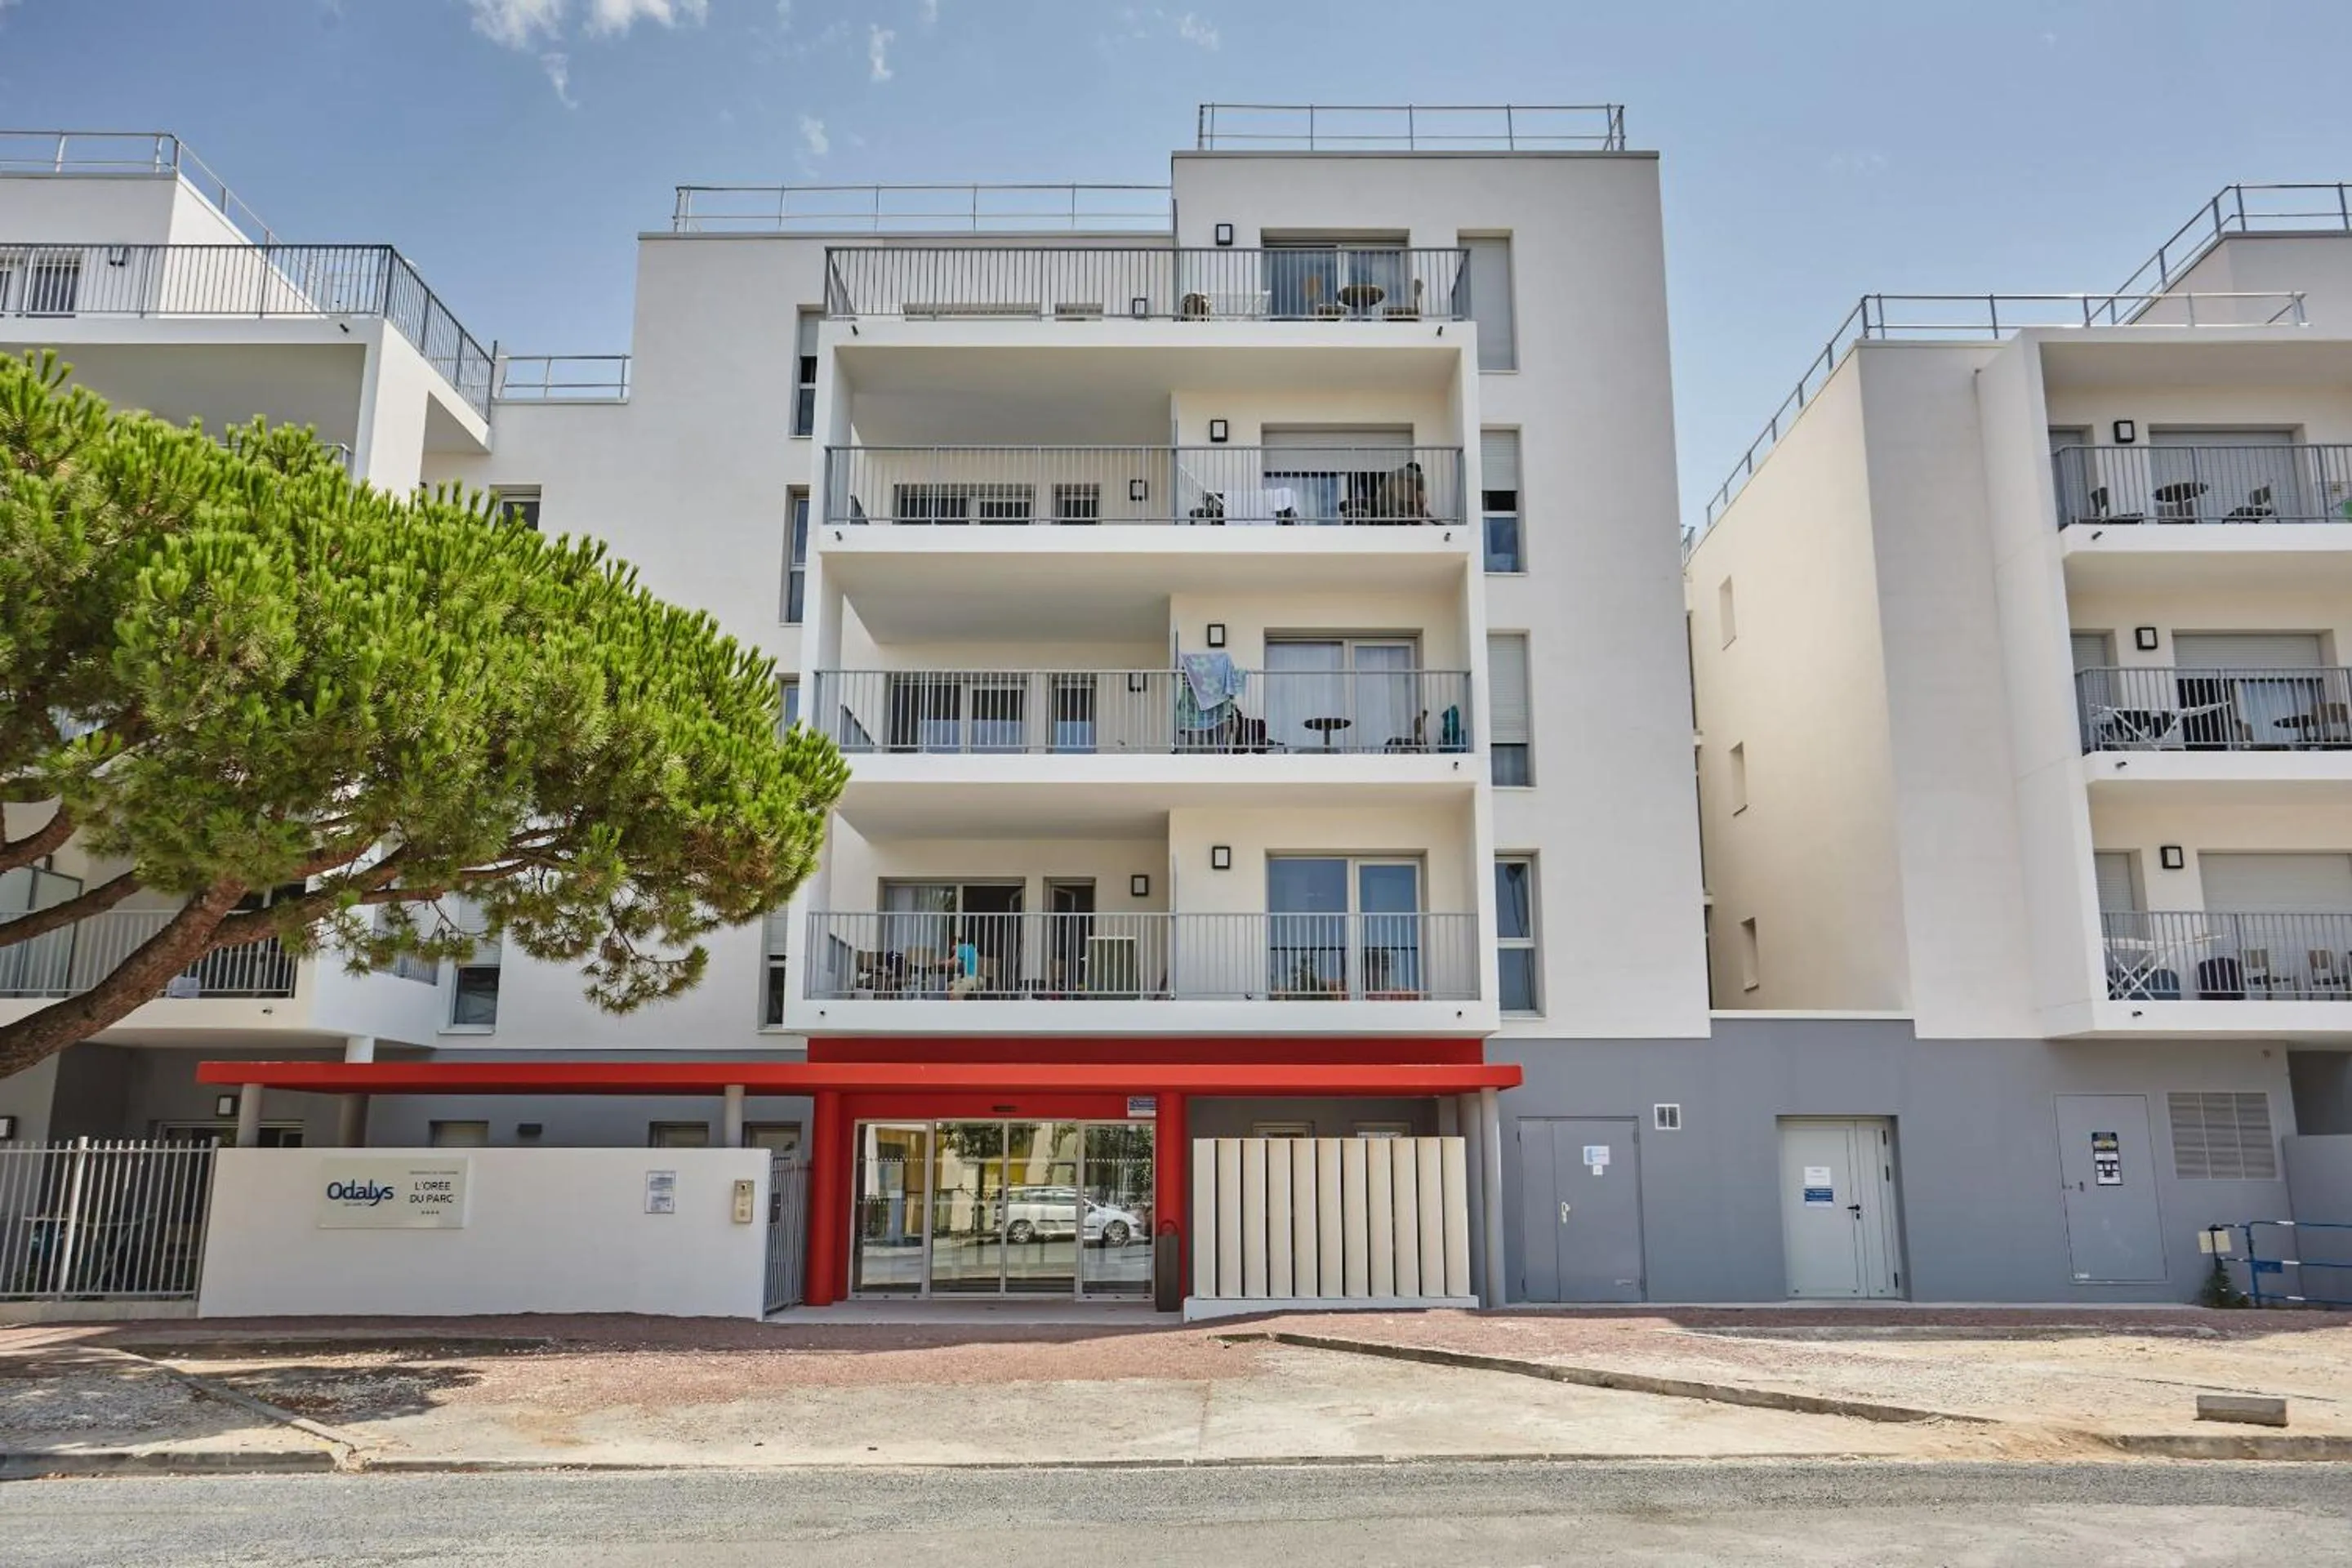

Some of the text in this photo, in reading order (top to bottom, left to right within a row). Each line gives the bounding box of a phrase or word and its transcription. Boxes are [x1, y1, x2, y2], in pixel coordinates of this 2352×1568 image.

[327, 1178, 394, 1206] Odalys
[409, 1194, 454, 1203] DU PARC
